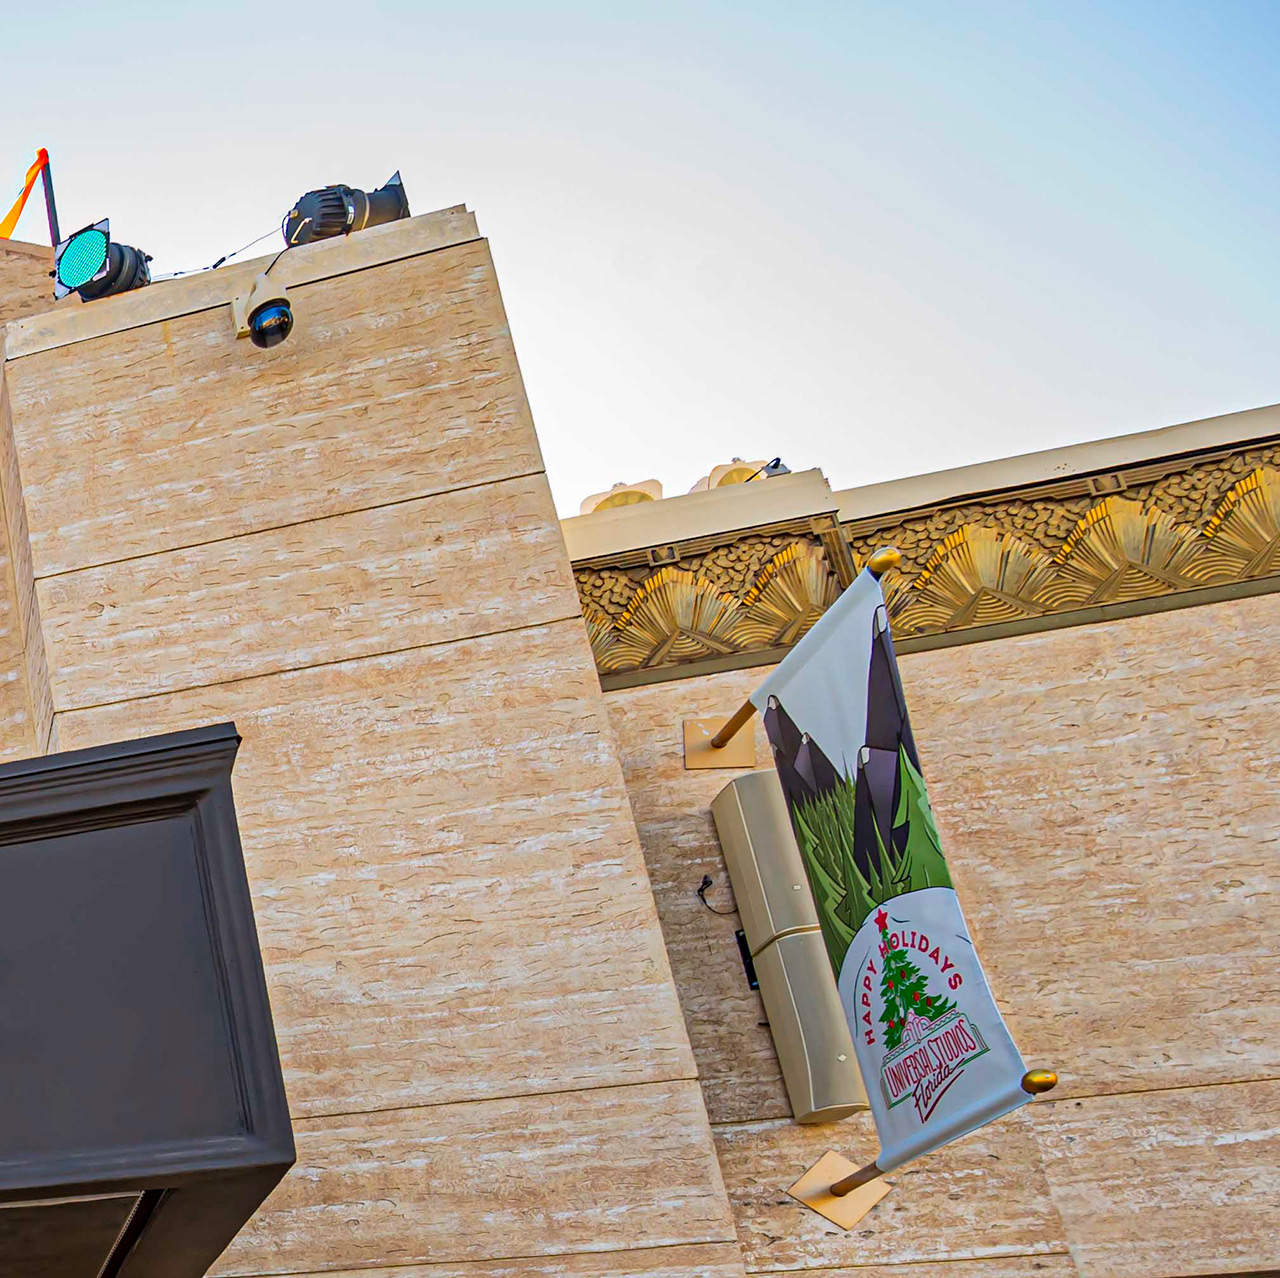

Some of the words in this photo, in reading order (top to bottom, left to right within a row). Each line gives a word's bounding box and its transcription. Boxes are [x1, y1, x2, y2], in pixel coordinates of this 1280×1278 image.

[861, 958, 878, 1046] HAPPY
[878, 930, 964, 991] HOLIDAYS
[883, 1043, 938, 1099] UNIVERSAL
[928, 1018, 977, 1070] STUDIOS
